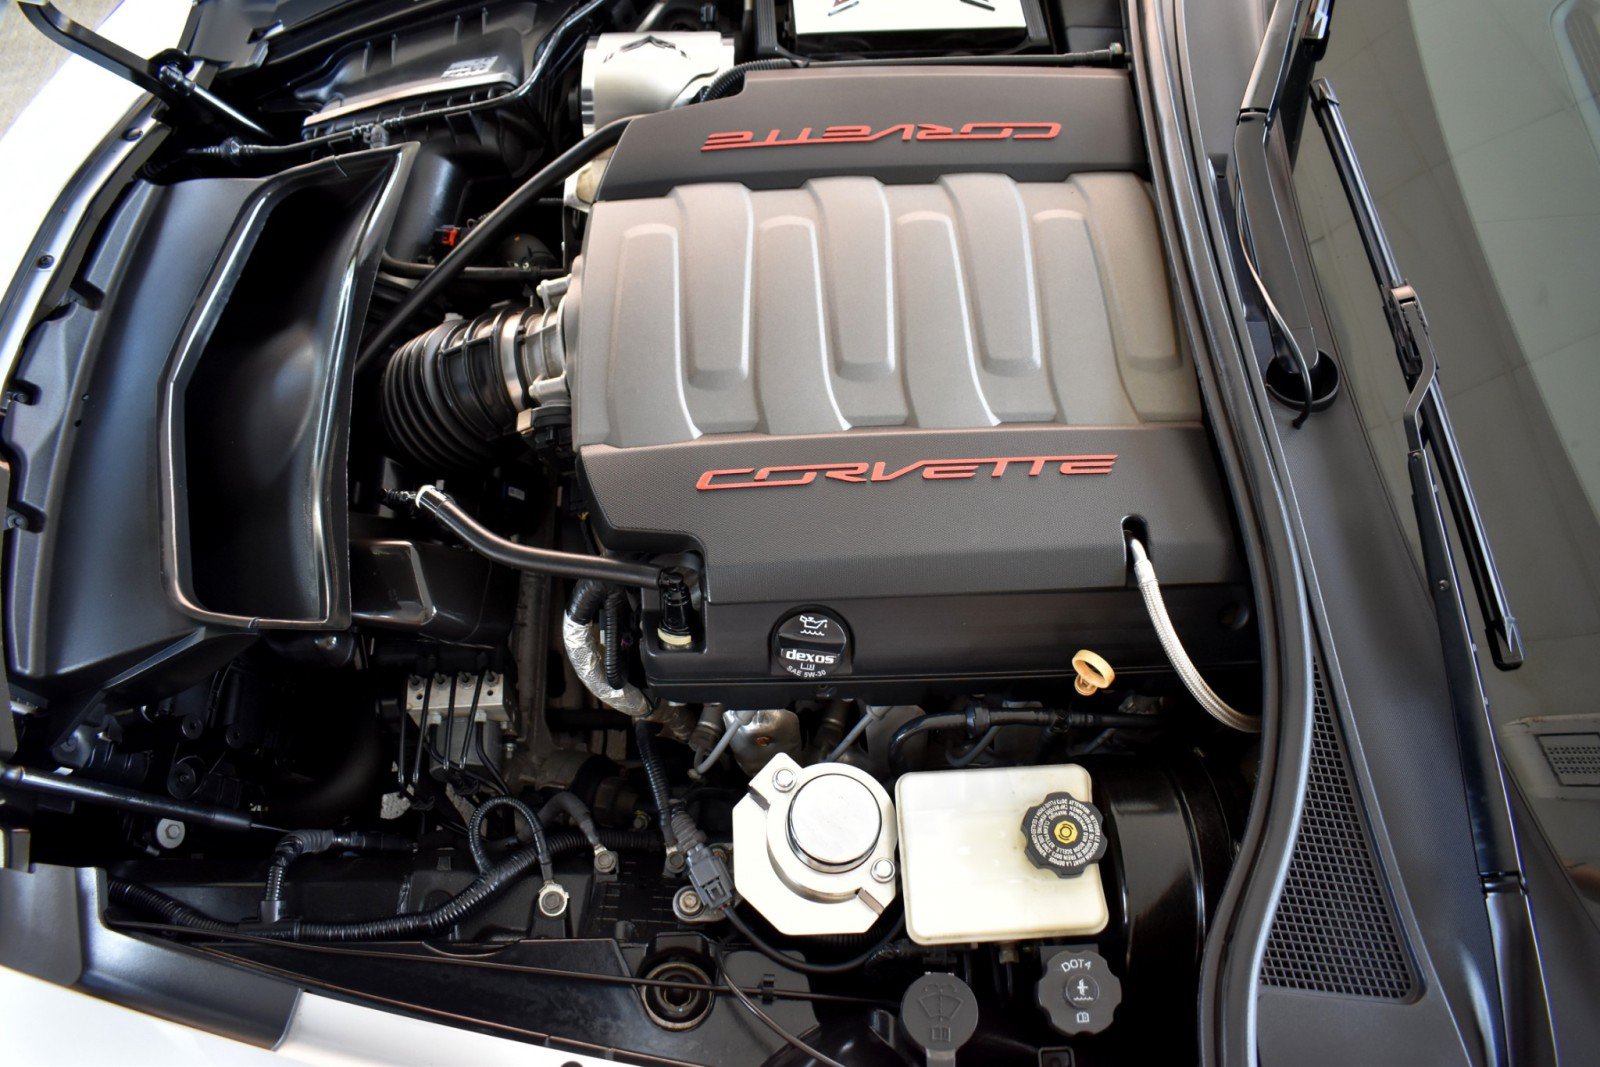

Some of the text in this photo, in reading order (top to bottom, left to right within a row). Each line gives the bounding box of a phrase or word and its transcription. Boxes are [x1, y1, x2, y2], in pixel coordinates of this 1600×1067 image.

[700, 122, 1062, 152] CORVETTE
[696, 453, 1120, 491] CORVETTE
[786, 649, 834, 664] dexos
[786, 665, 827, 678] SAE 5W-30
